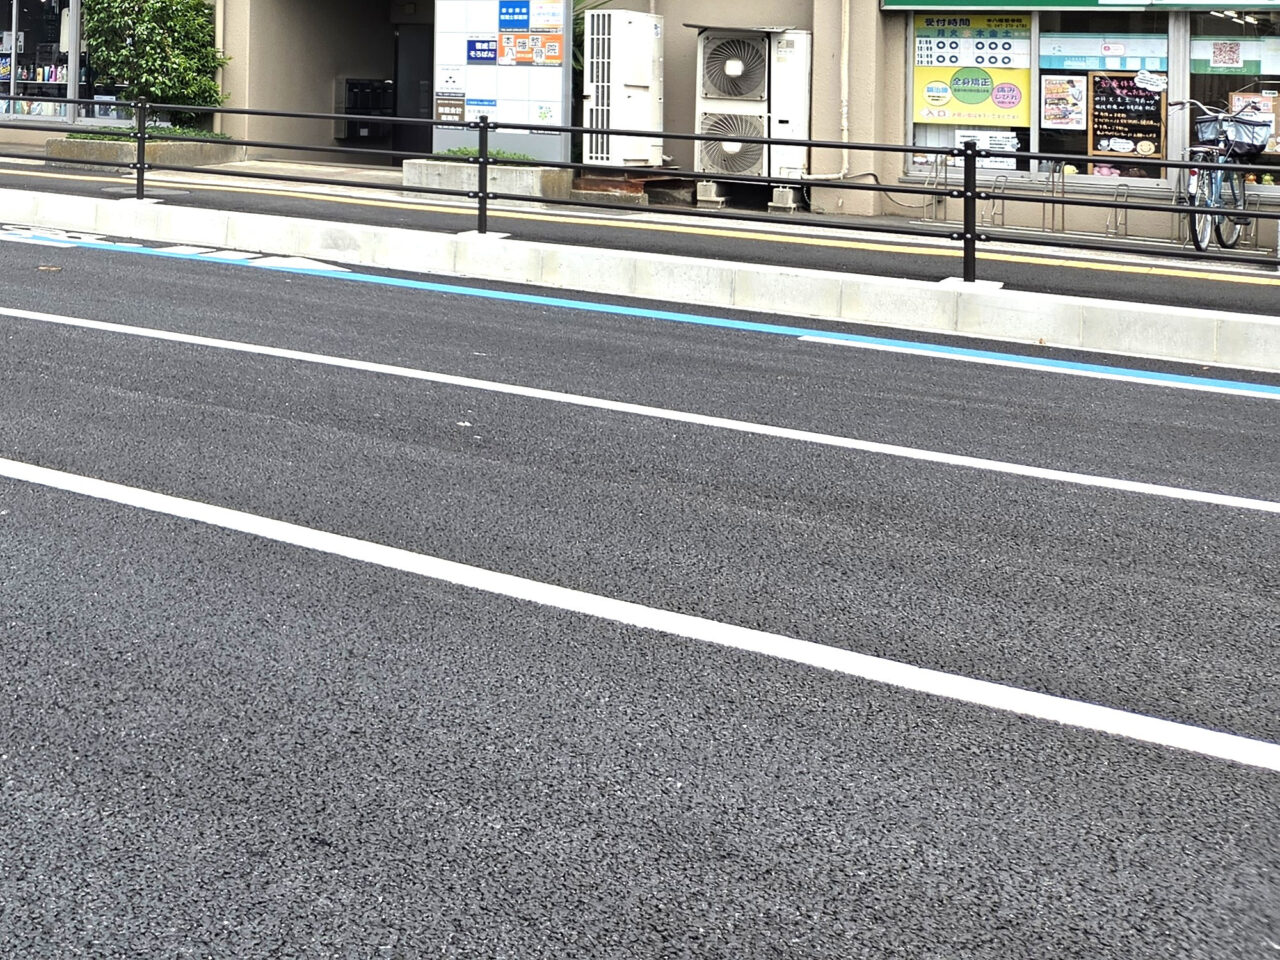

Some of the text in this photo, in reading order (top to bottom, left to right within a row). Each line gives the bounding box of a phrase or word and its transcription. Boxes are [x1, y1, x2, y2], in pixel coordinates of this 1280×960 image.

[925, 18, 970, 27] 受付時間
[975, 29, 985, 37] 木
[1002, 29, 1012, 37] 土
[953, 77, 990, 87] 全身矯正
[926, 109, 946, 117] 入口
